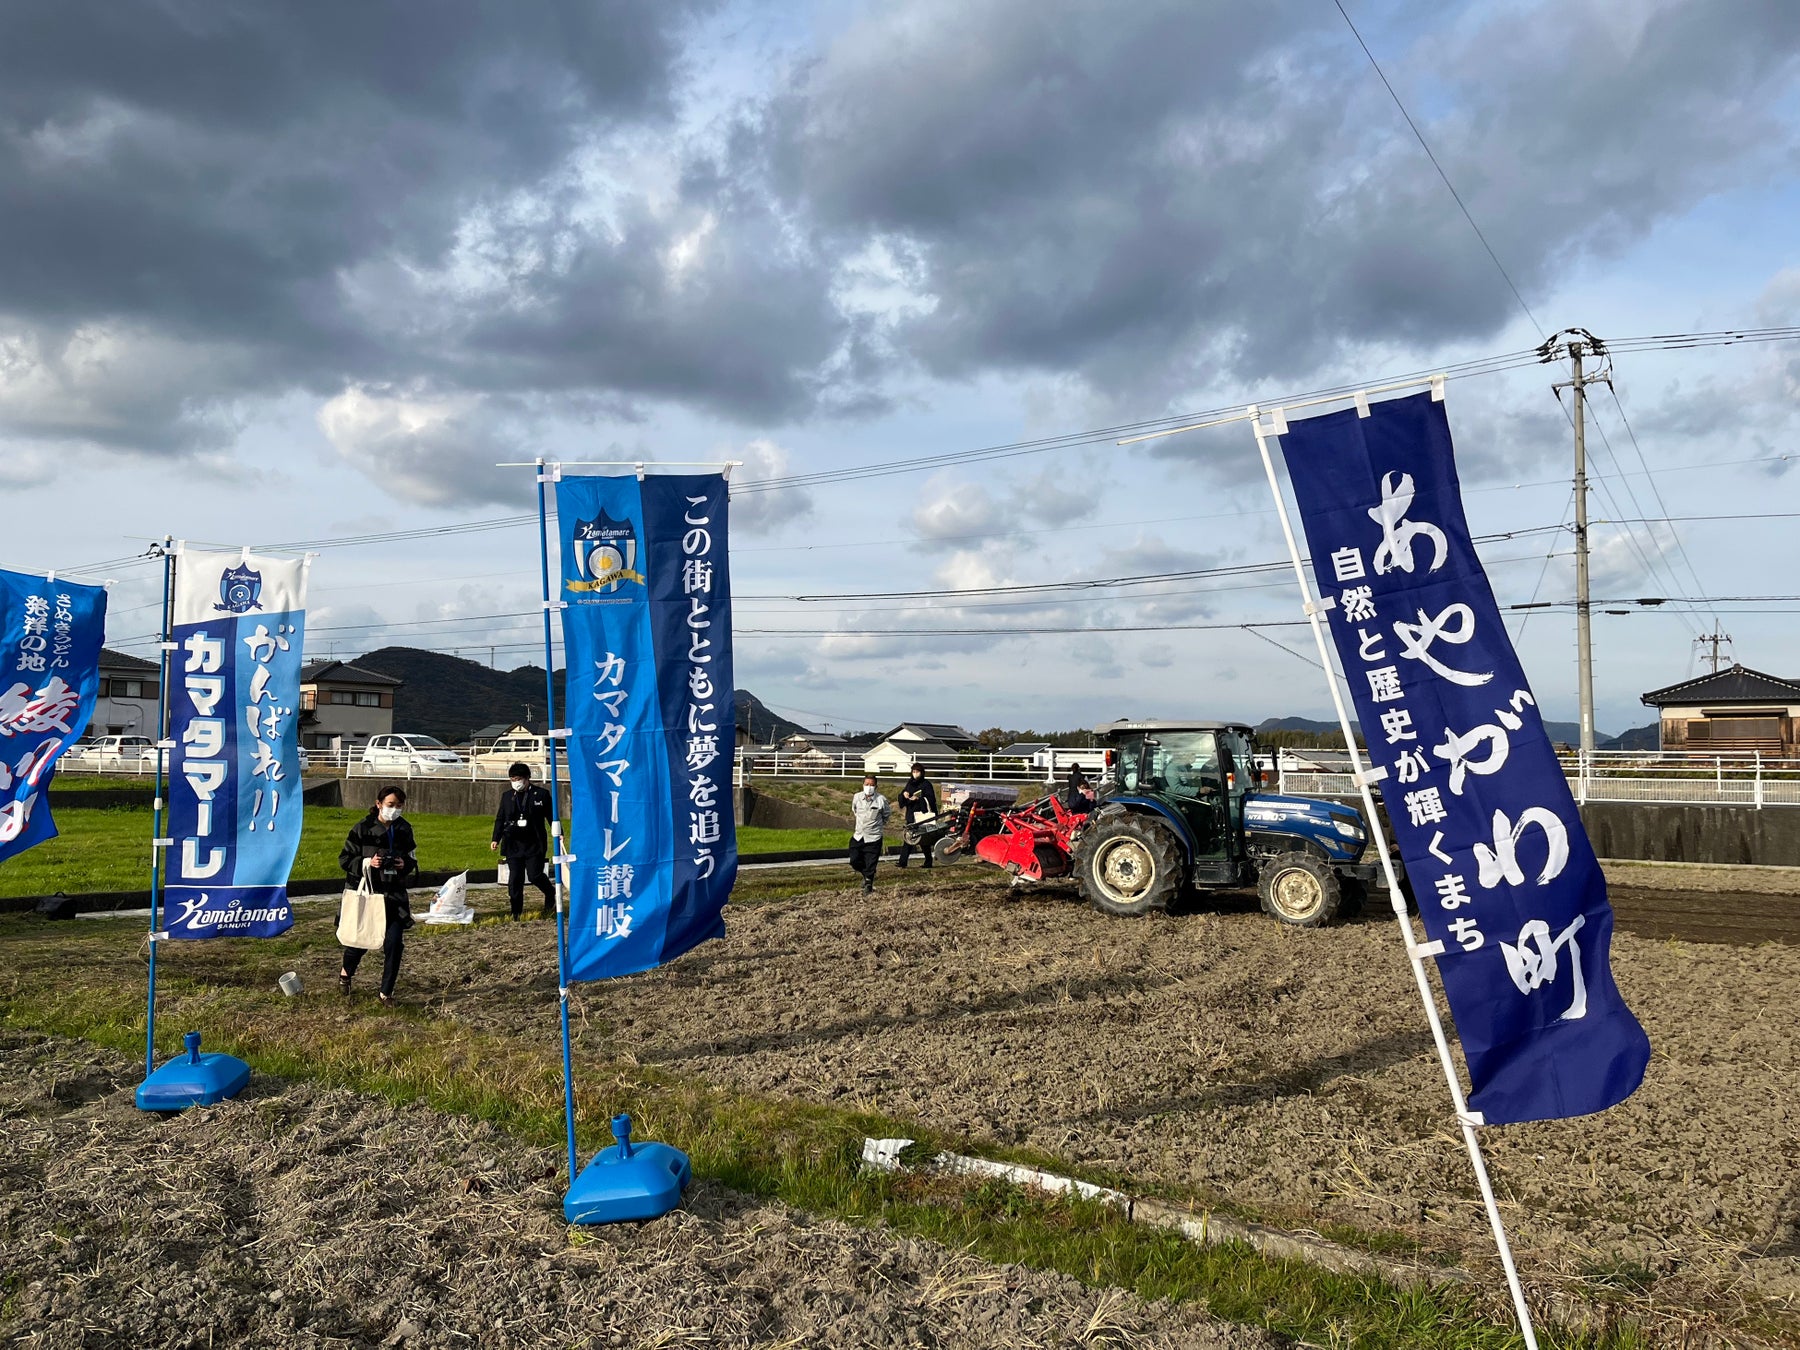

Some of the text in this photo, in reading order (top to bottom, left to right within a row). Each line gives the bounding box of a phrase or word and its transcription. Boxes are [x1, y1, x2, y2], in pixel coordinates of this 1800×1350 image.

[16, 595, 50, 671] 発祥の地
[50, 593, 73, 668] さぬきうどん
[588, 571, 624, 589] KAGAWA
[682, 495, 721, 880] この街とともに夢を追う
[181, 631, 227, 878] カマタマーレ
[243, 624, 296, 831] がんばれ!!
[593, 651, 635, 941] カマタマーレ讃岐
[1330, 546, 1485, 953] 自然と歴史が輝くまち
[1368, 470, 1588, 1022] あやがわ町
[170, 893, 288, 929] Kamatamare
